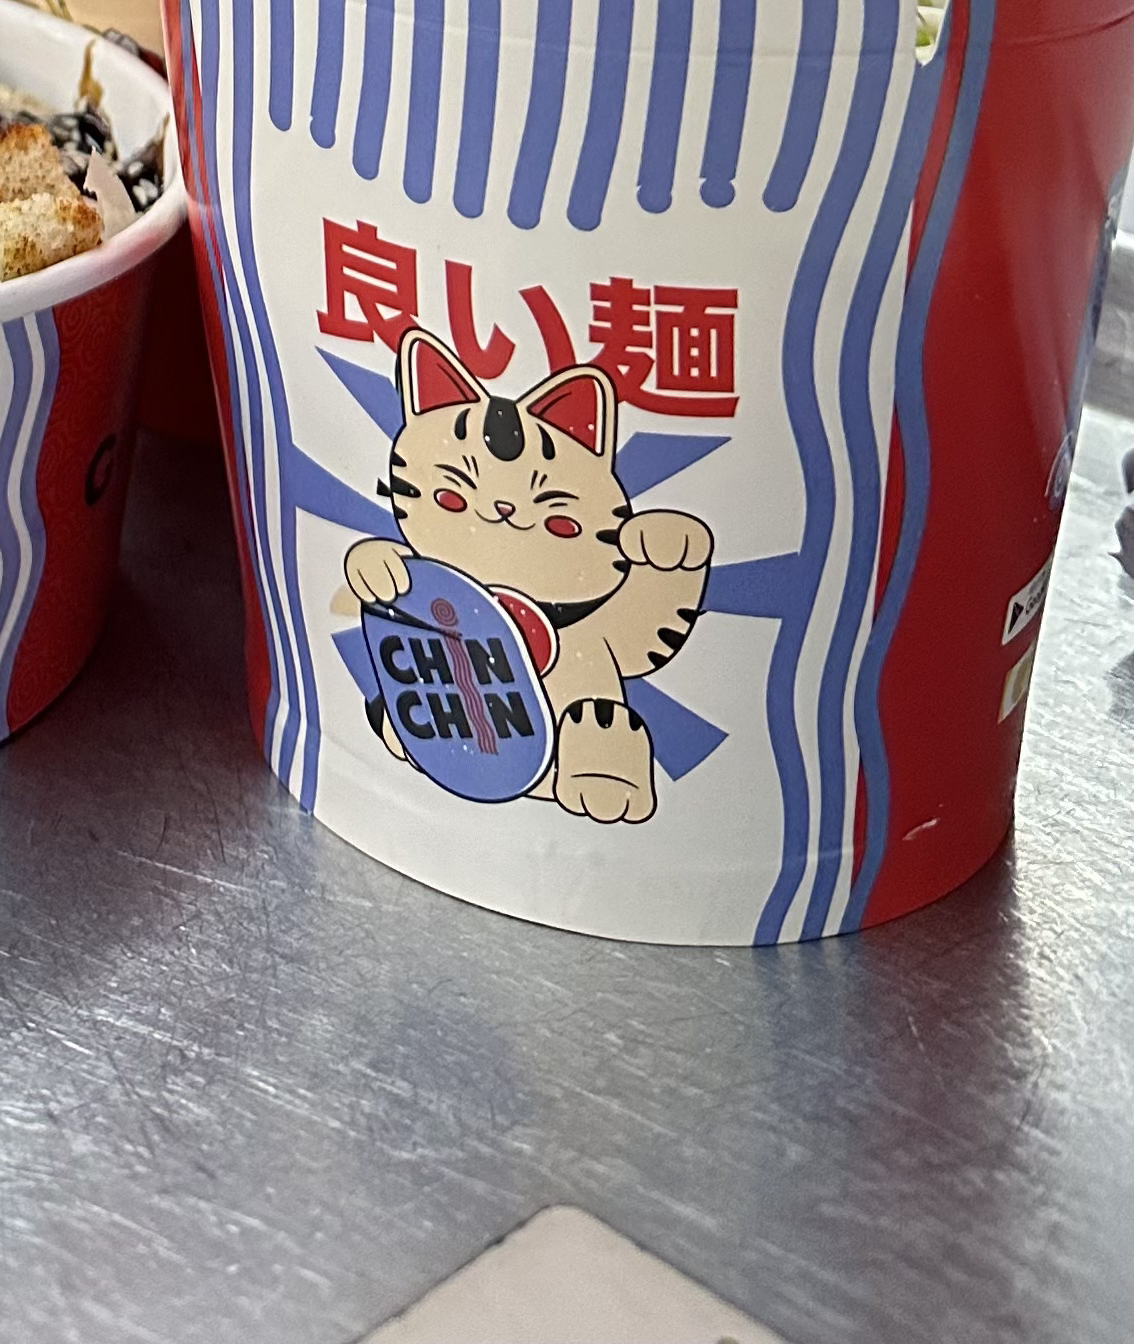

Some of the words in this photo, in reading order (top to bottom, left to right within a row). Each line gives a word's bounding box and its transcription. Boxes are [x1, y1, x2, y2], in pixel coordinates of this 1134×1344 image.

[315, 216, 741, 419] 良い麺
[378, 634, 516, 685] CHIN
[395, 690, 535, 741] CHIN
